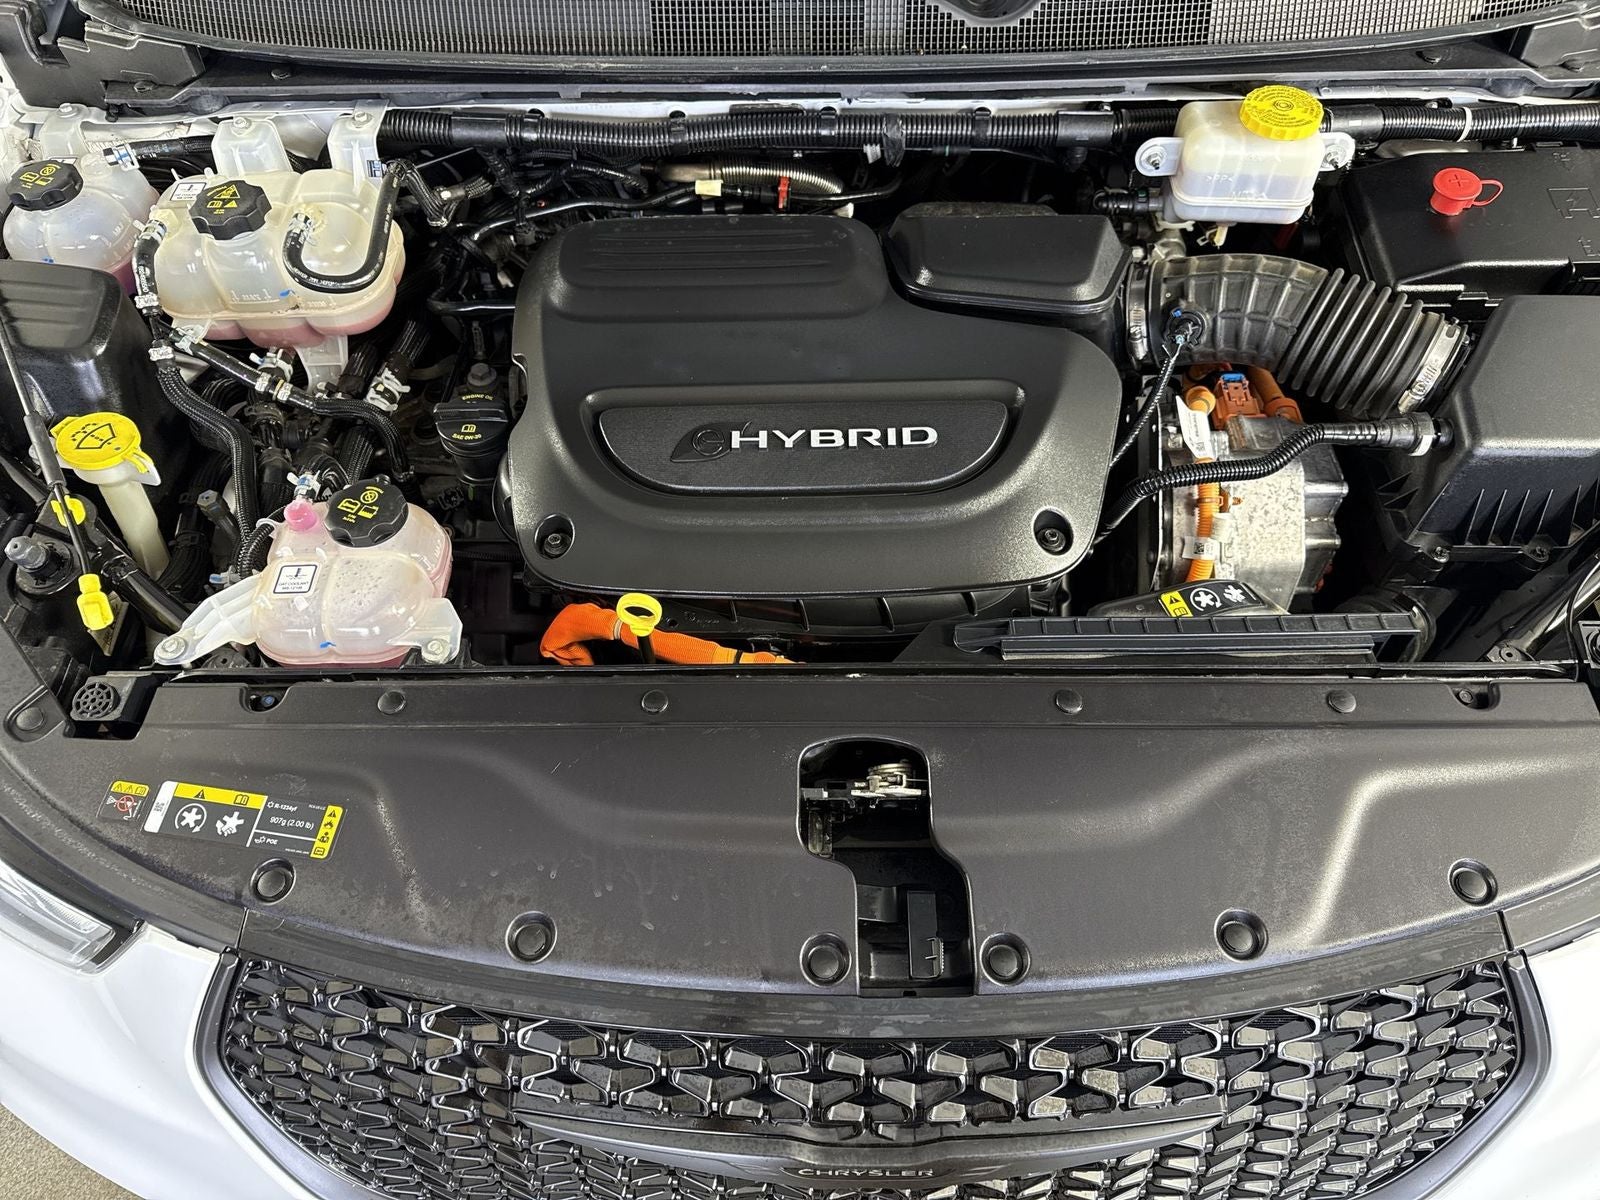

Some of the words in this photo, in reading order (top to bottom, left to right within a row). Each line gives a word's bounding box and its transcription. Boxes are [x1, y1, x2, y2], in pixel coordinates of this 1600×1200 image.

[731, 426, 938, 450] HYBRID
[274, 804, 298, 812] R-1234yf
[270, 816, 286, 826] 907g
[287, 818, 305, 828] (2.00
[305, 822, 314, 830] lb)
[266, 837, 278, 845] POE
[798, 1168, 934, 1177] CHRYSLER
